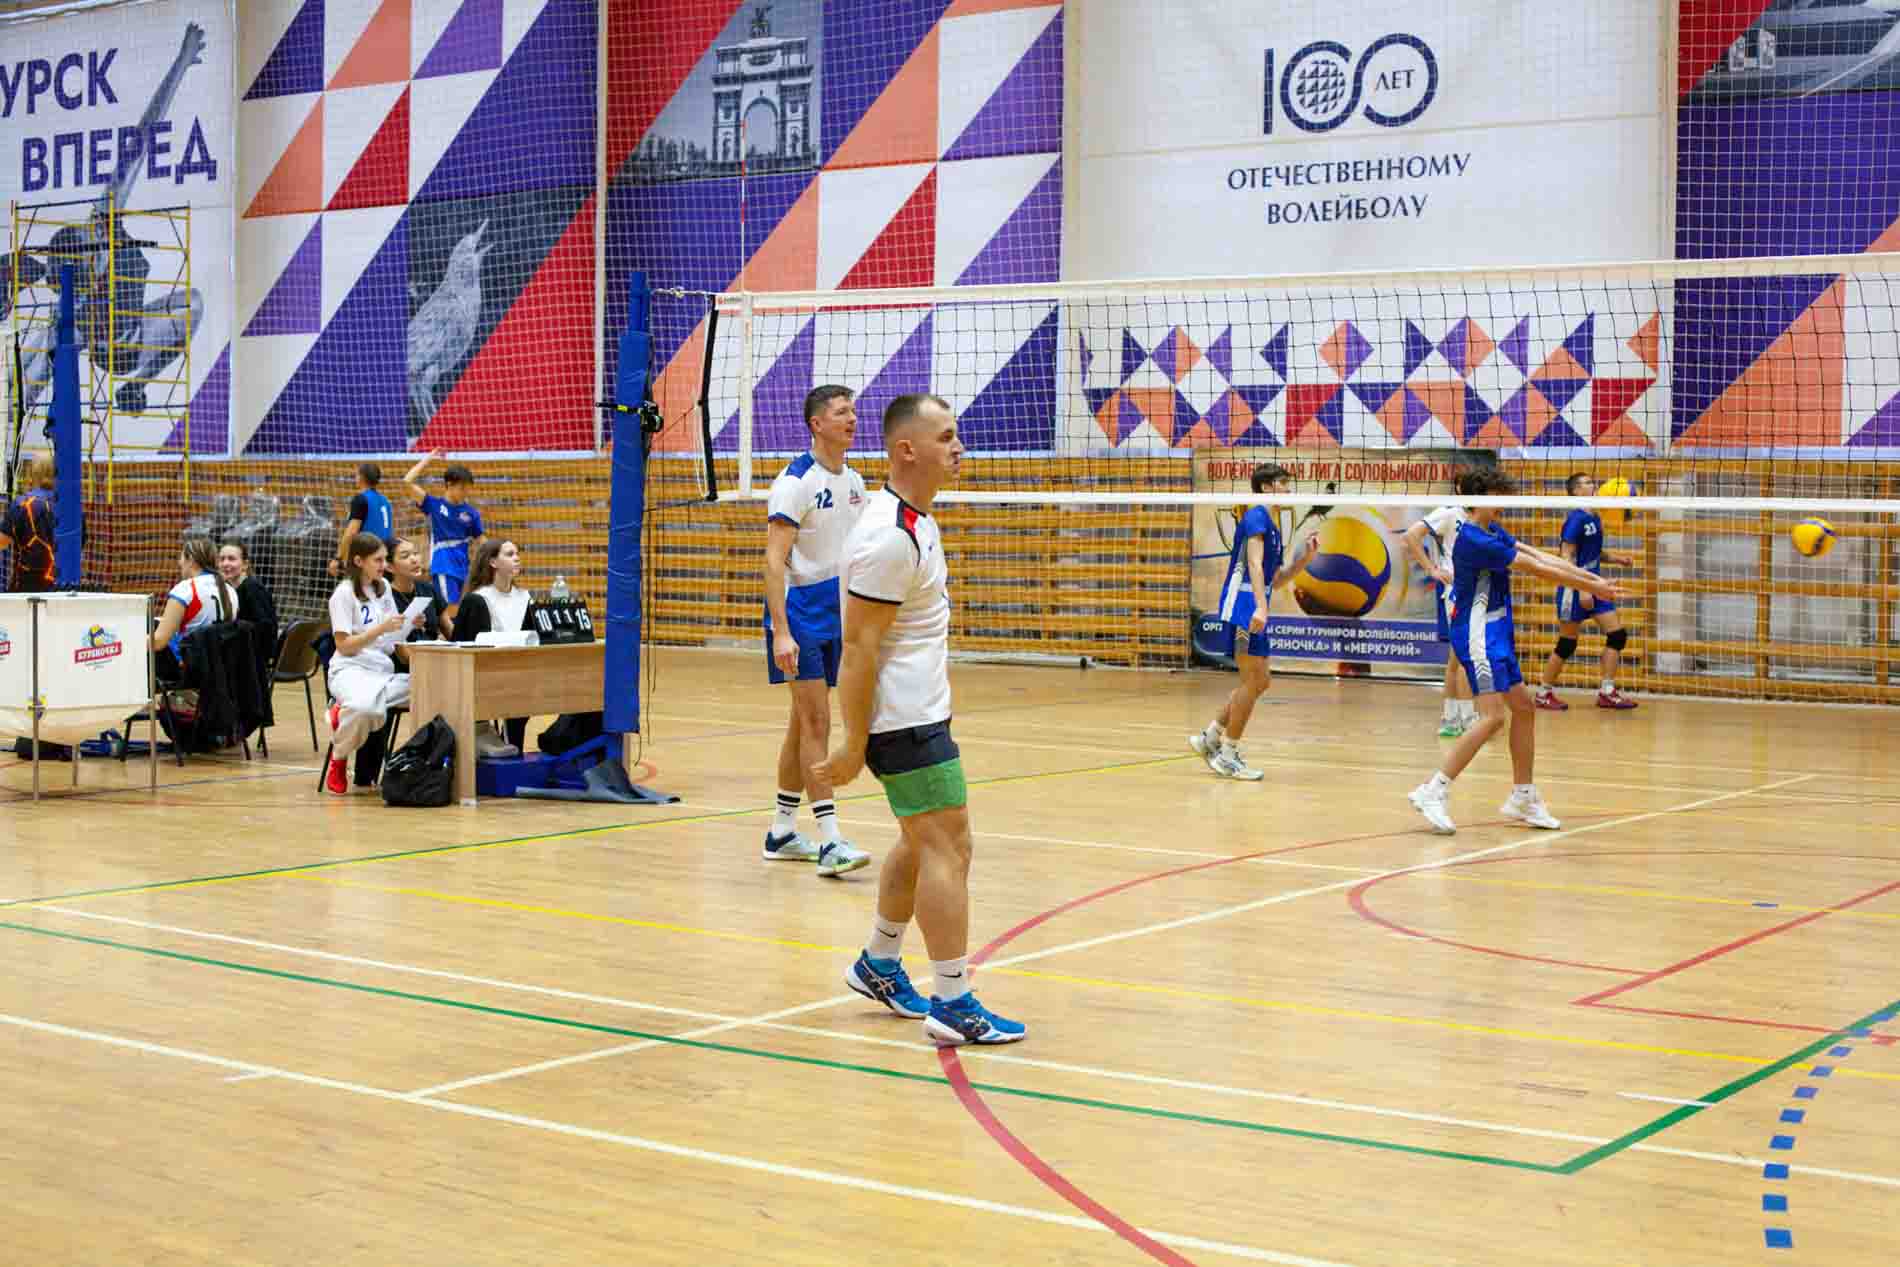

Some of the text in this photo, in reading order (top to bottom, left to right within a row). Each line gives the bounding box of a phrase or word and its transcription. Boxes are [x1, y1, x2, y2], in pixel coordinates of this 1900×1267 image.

[0, 48, 118, 118] УРСК
[1375, 69, 1415, 90] ЛЕТ
[22, 115, 217, 192] ВПЕРЕД
[1228, 153, 1471, 189] ОТЕЧЕСТВЕННОМУ
[1267, 194, 1428, 224] ВОЛЕЙБОЛУ
[1310, 463, 1340, 480] ЛИГА
[1345, 463, 1438, 480] СОЛОВЬИНОГО
[815, 488, 833, 509] 12
[381, 505, 388, 528] 1
[361, 605, 374, 625] 2
[535, 608, 591, 631] 10 1 1 15
[1275, 625, 1304, 635] СЕРИИ
[1307, 626, 1356, 638] ТУРНИРОВ
[1358, 628, 1437, 641] ВОЛЕЙБОЛЬНЫЕ
[1270, 639, 1421, 656] РЯНОЧКА» И «МЕРКУРИЙ»
